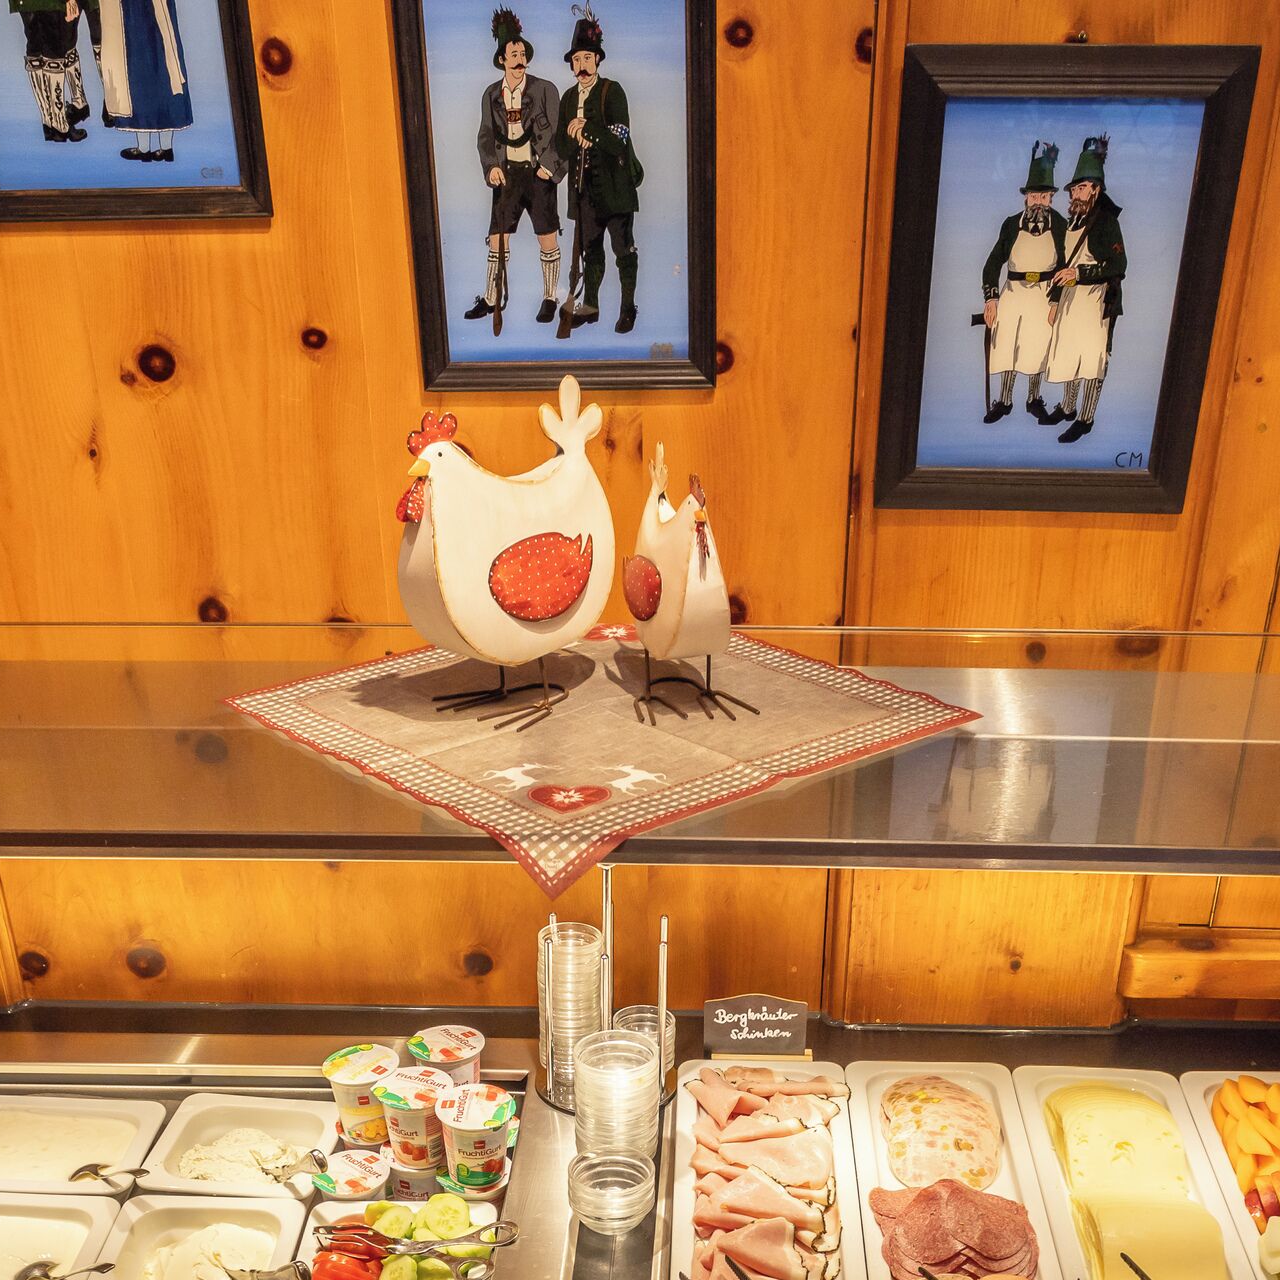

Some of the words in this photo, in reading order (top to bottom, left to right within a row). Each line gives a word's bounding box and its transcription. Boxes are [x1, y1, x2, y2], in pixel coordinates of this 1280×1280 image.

[1115, 451, 1143, 468] CM
[713, 1006, 798, 1027] Bergkräuter
[440, 1028, 477, 1051] FruchtiGurt
[395, 1072, 447, 1090] FruchtiGurt
[458, 1145, 502, 1157] FruchtiGurt
[342, 1153, 382, 1179] FruchtiGurt
